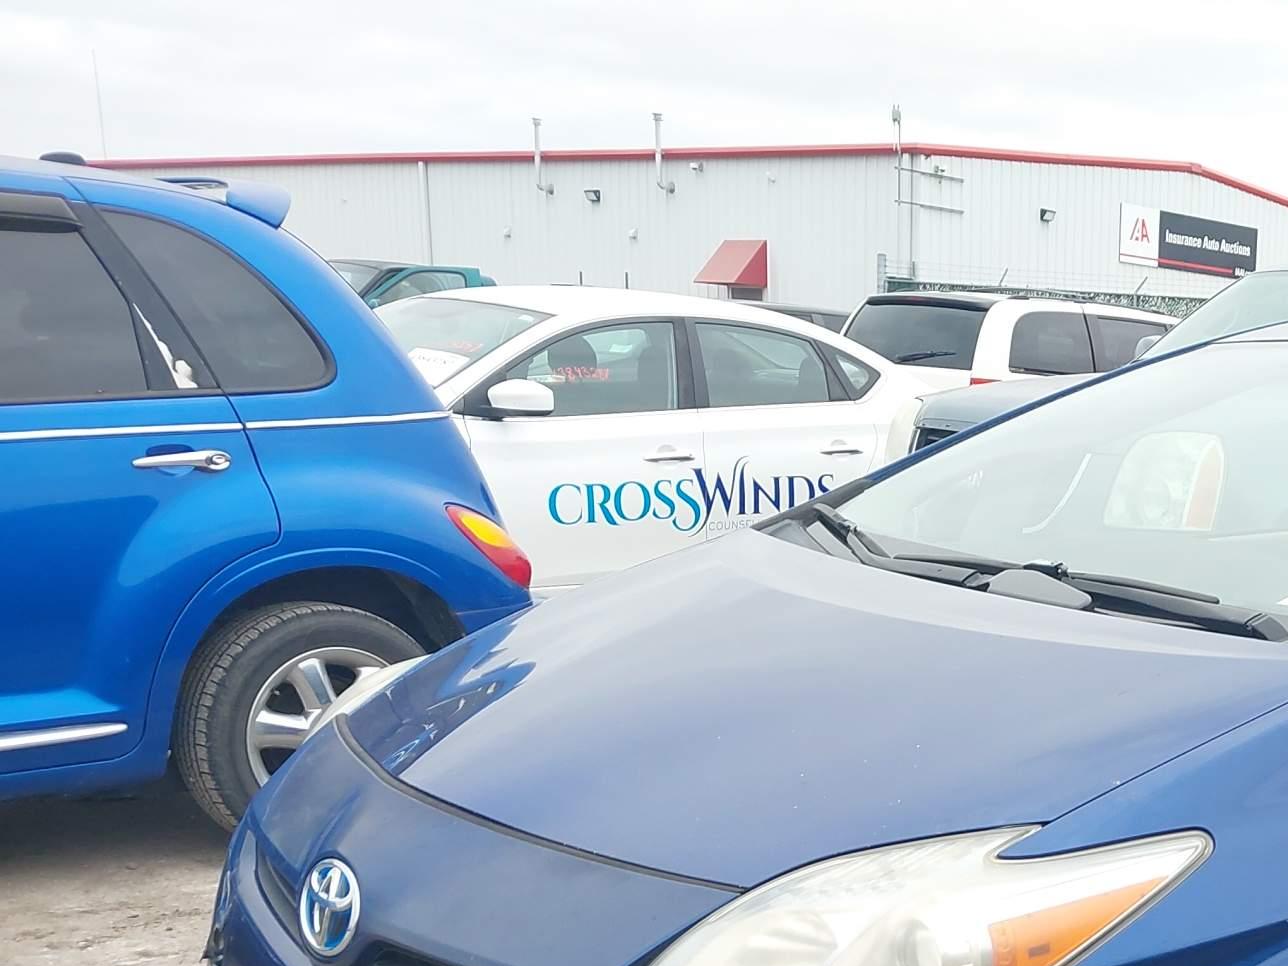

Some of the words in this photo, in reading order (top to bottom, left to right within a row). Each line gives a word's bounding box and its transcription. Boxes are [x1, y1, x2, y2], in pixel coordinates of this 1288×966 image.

[1165, 229, 1202, 248] Insurance
[1203, 235, 1220, 251] Auto
[1220, 238, 1251, 257] Auctions
